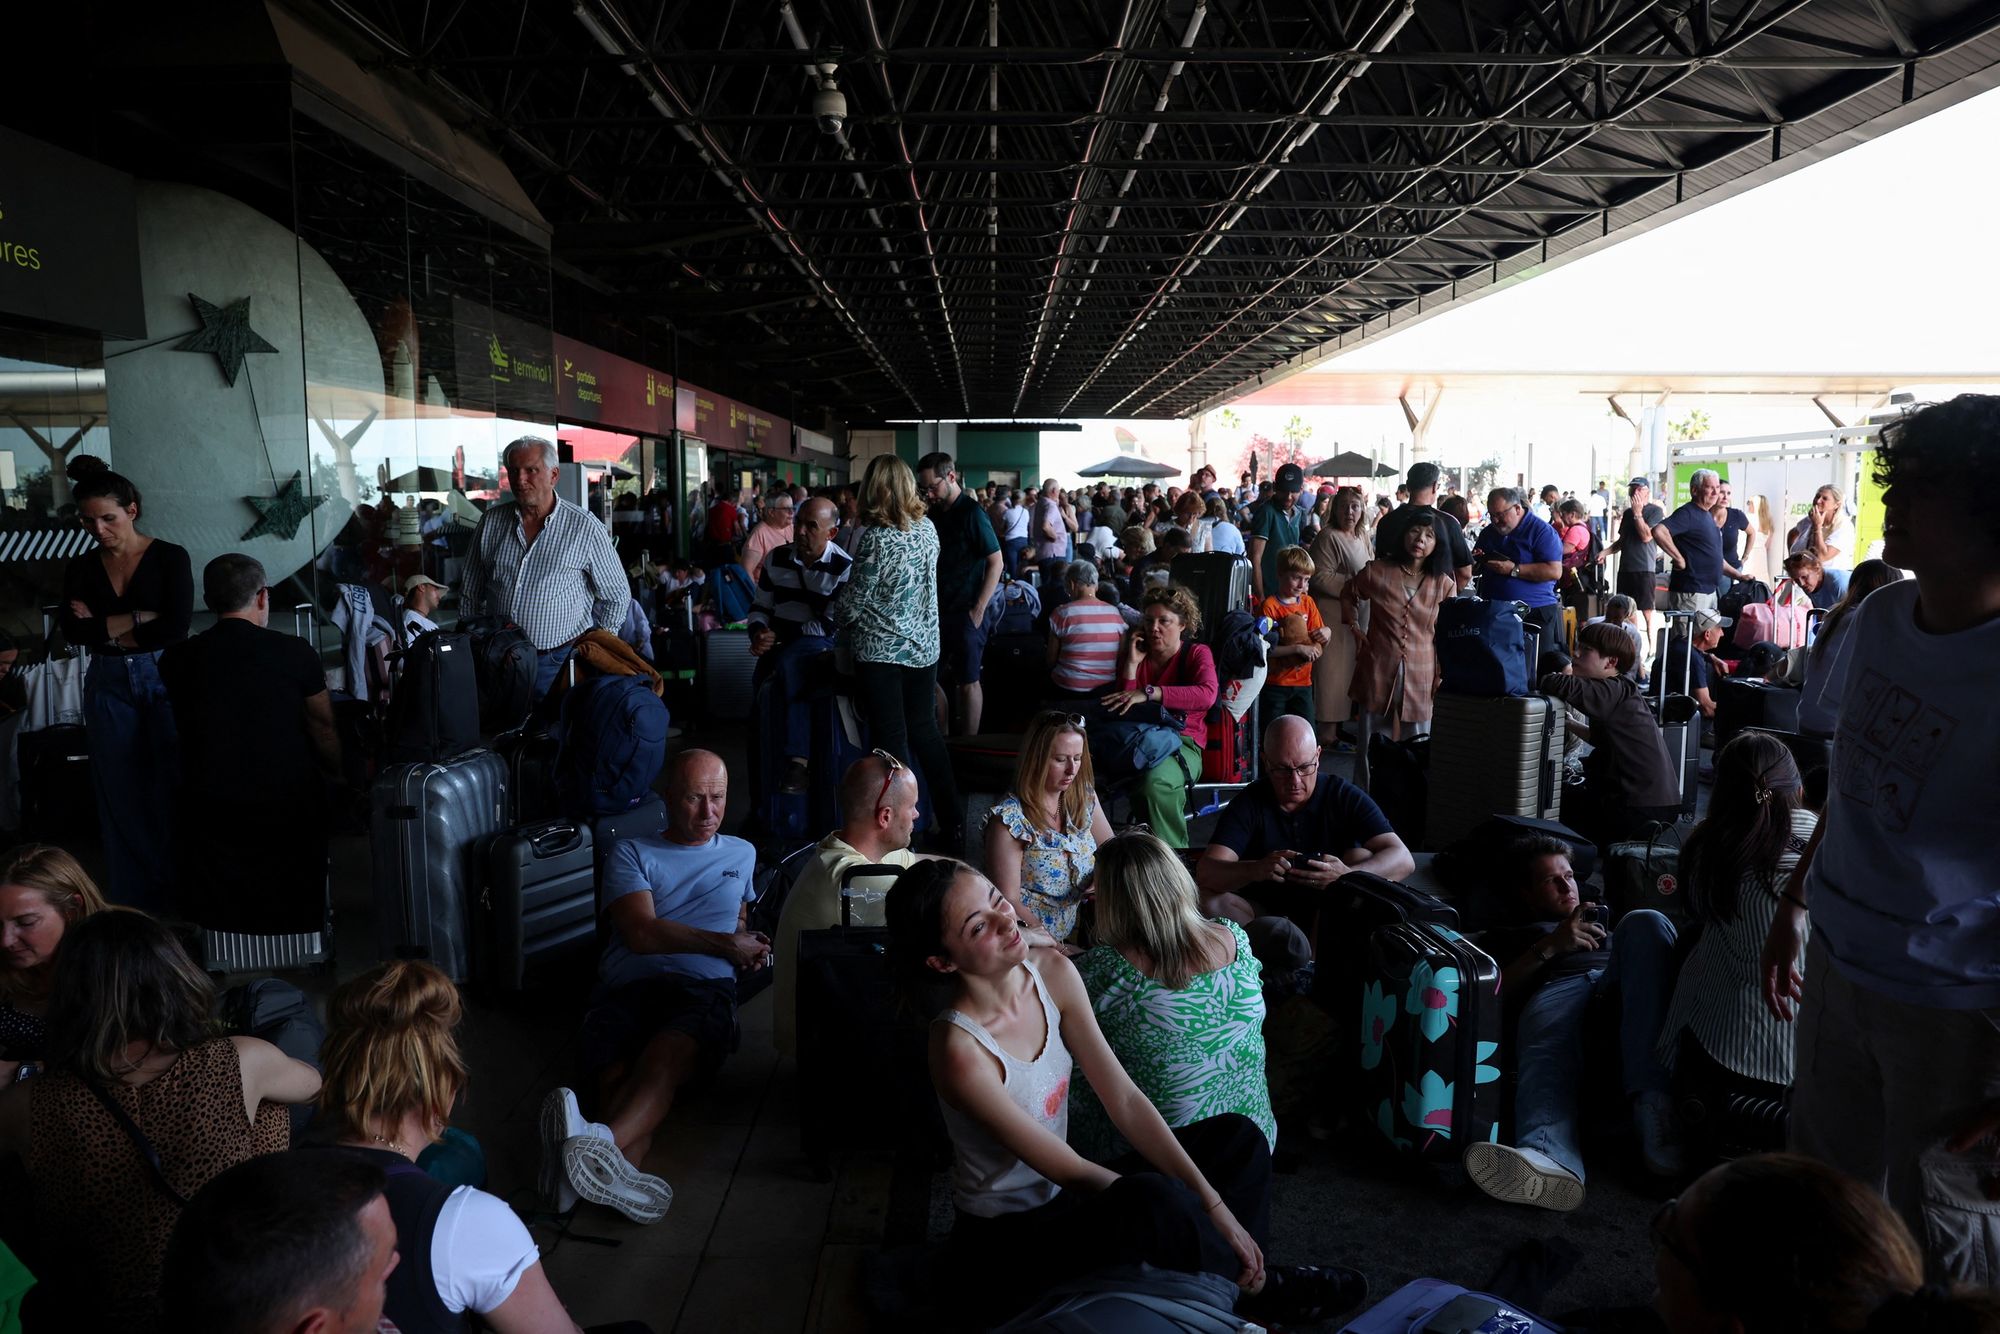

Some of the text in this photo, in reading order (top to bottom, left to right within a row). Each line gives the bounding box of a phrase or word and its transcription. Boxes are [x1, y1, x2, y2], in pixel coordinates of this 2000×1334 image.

[513, 356, 552, 384] terminal 1
[576, 371, 597, 386] partidas
[577, 385, 603, 404] departures
[1447, 627, 1480, 638] ILLUMS
